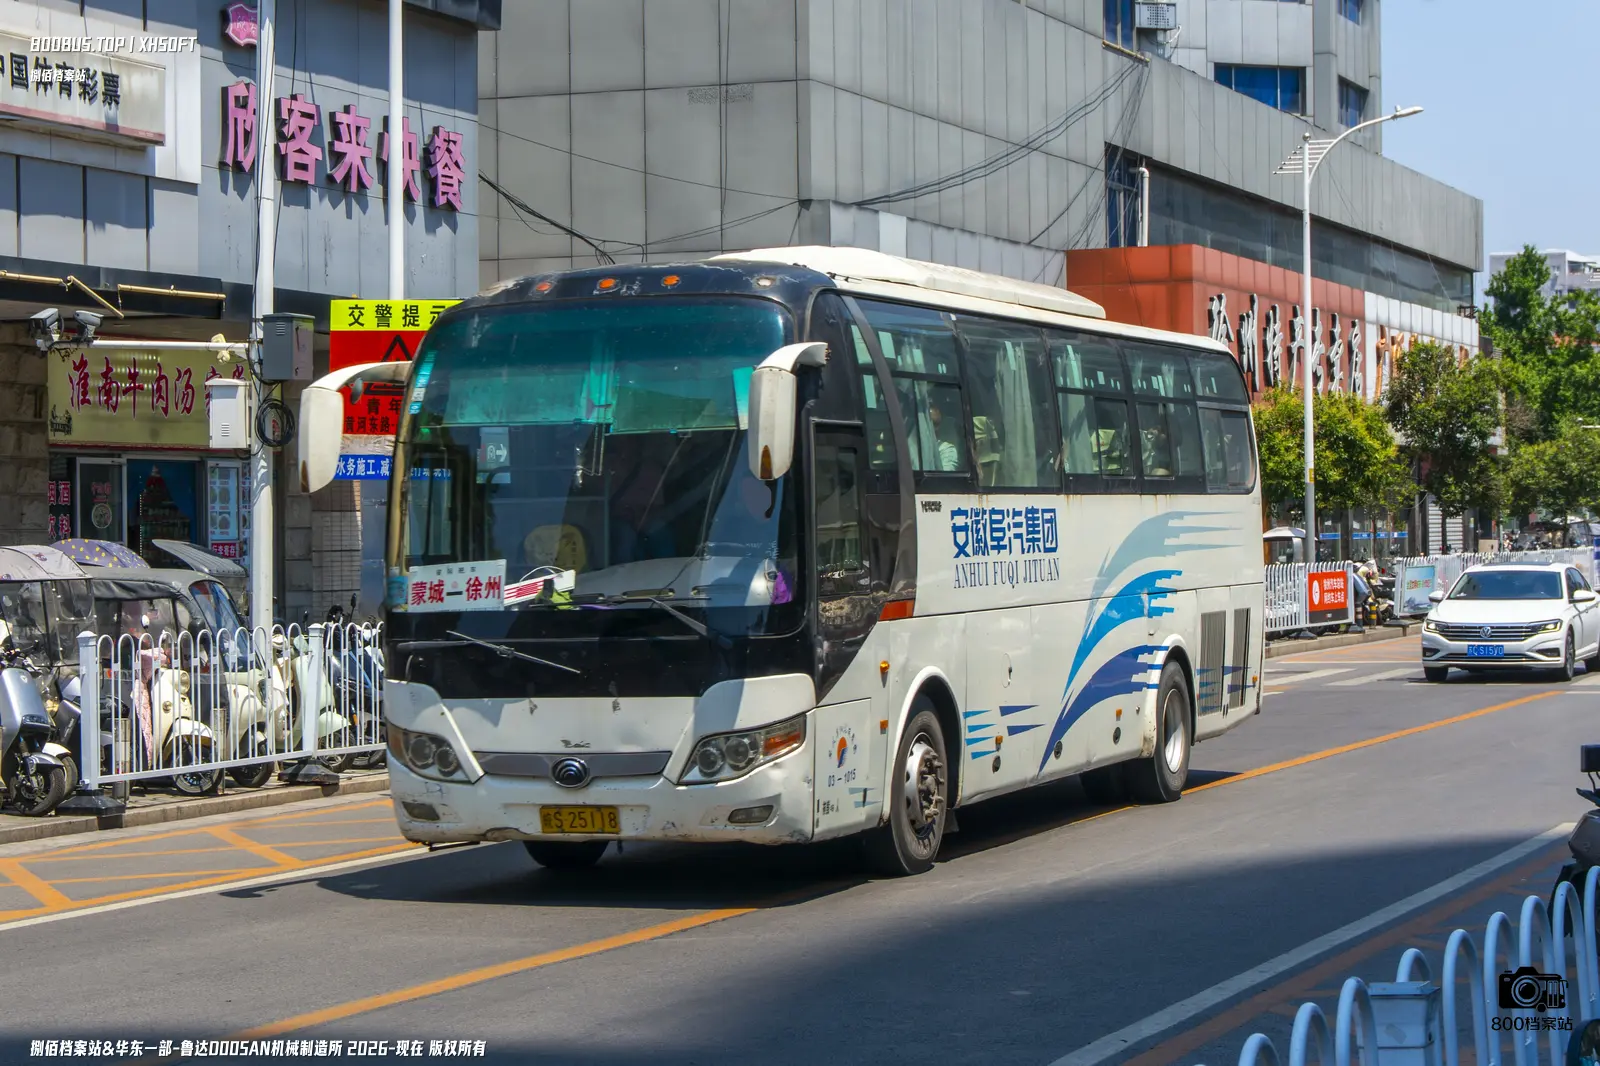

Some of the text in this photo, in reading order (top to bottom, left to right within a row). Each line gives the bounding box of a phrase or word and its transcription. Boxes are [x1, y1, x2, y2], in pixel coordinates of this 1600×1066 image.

[0, 52, 121, 109] 国体育彩票
[68, 353, 196, 419] 淮南牛肉汤
[950, 505, 1059, 559] 安徽阜汽集团
[954, 557, 1060, 589] ANHUI FUQI JITUAN
